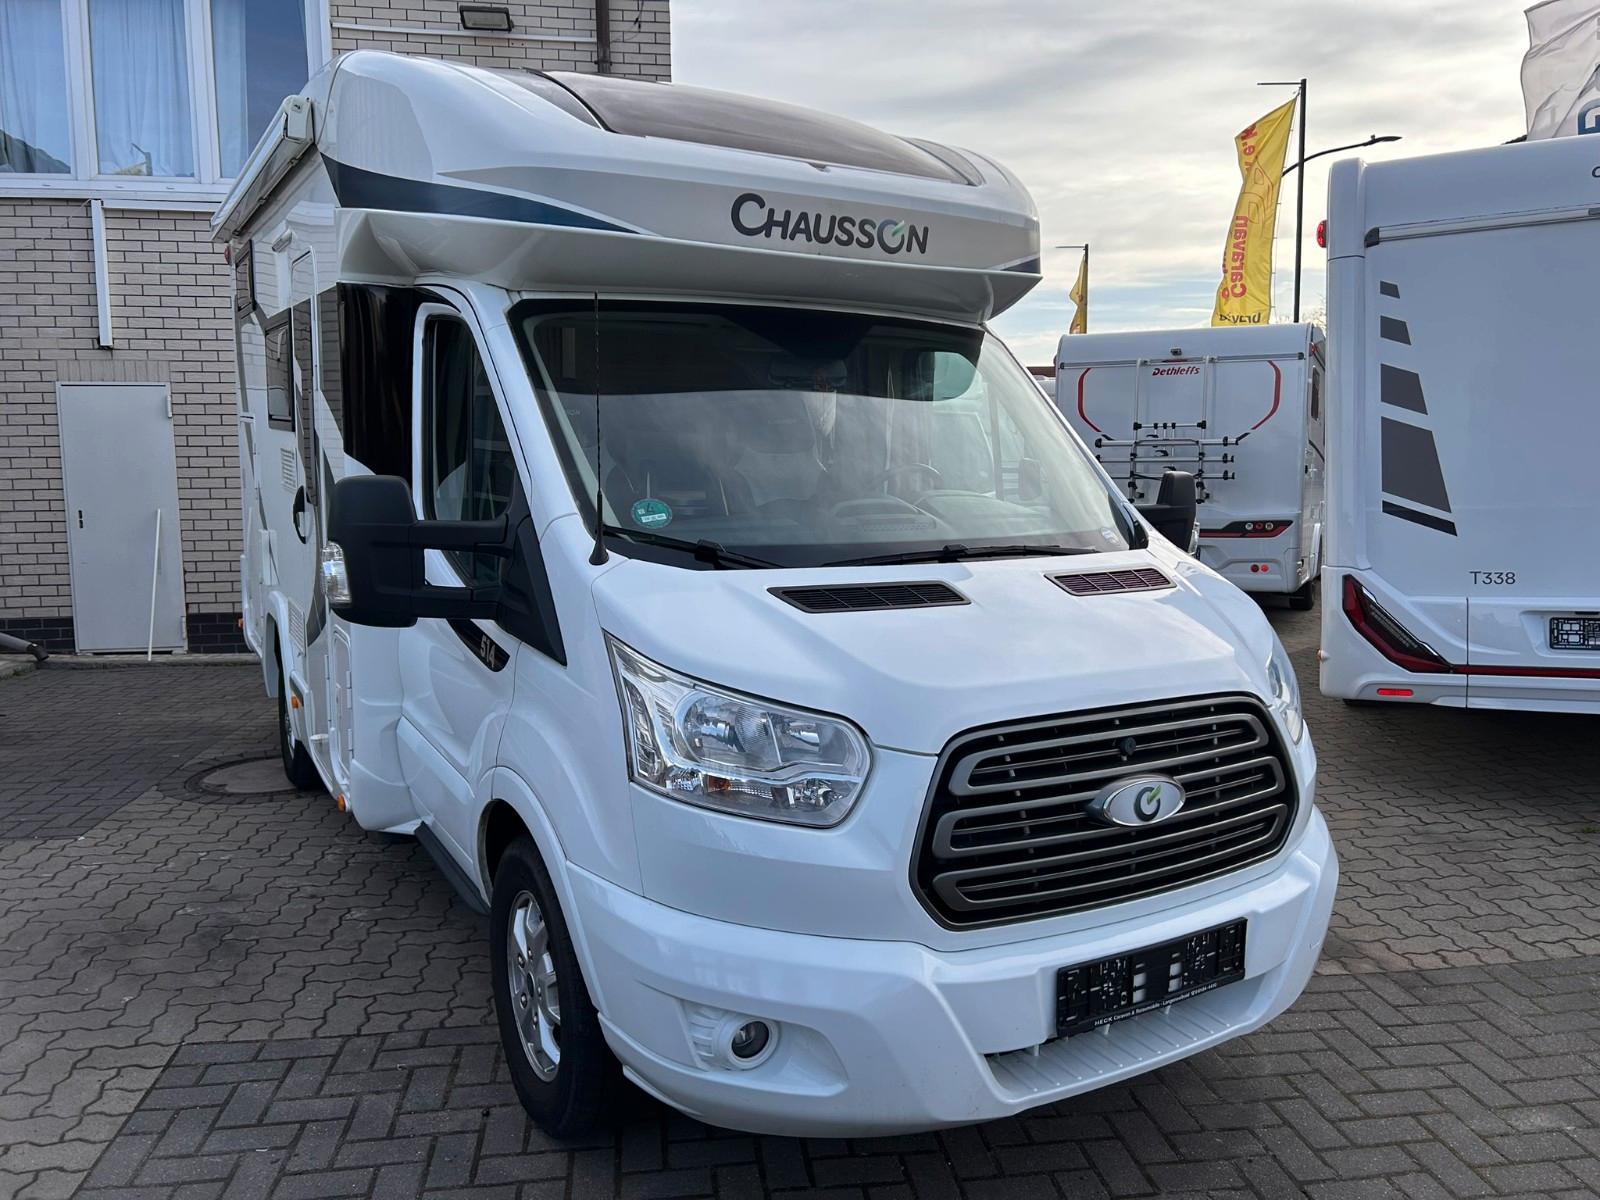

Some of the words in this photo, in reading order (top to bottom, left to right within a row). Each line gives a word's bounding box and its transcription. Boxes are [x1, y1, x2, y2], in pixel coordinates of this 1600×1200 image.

[731, 192, 929, 254] CHAUSSON
[1152, 366, 1200, 376] Dethleffs
[1469, 571, 1516, 585] T338
[480, 634, 496, 669] 514
[1094, 1015, 1113, 1026] HECK
